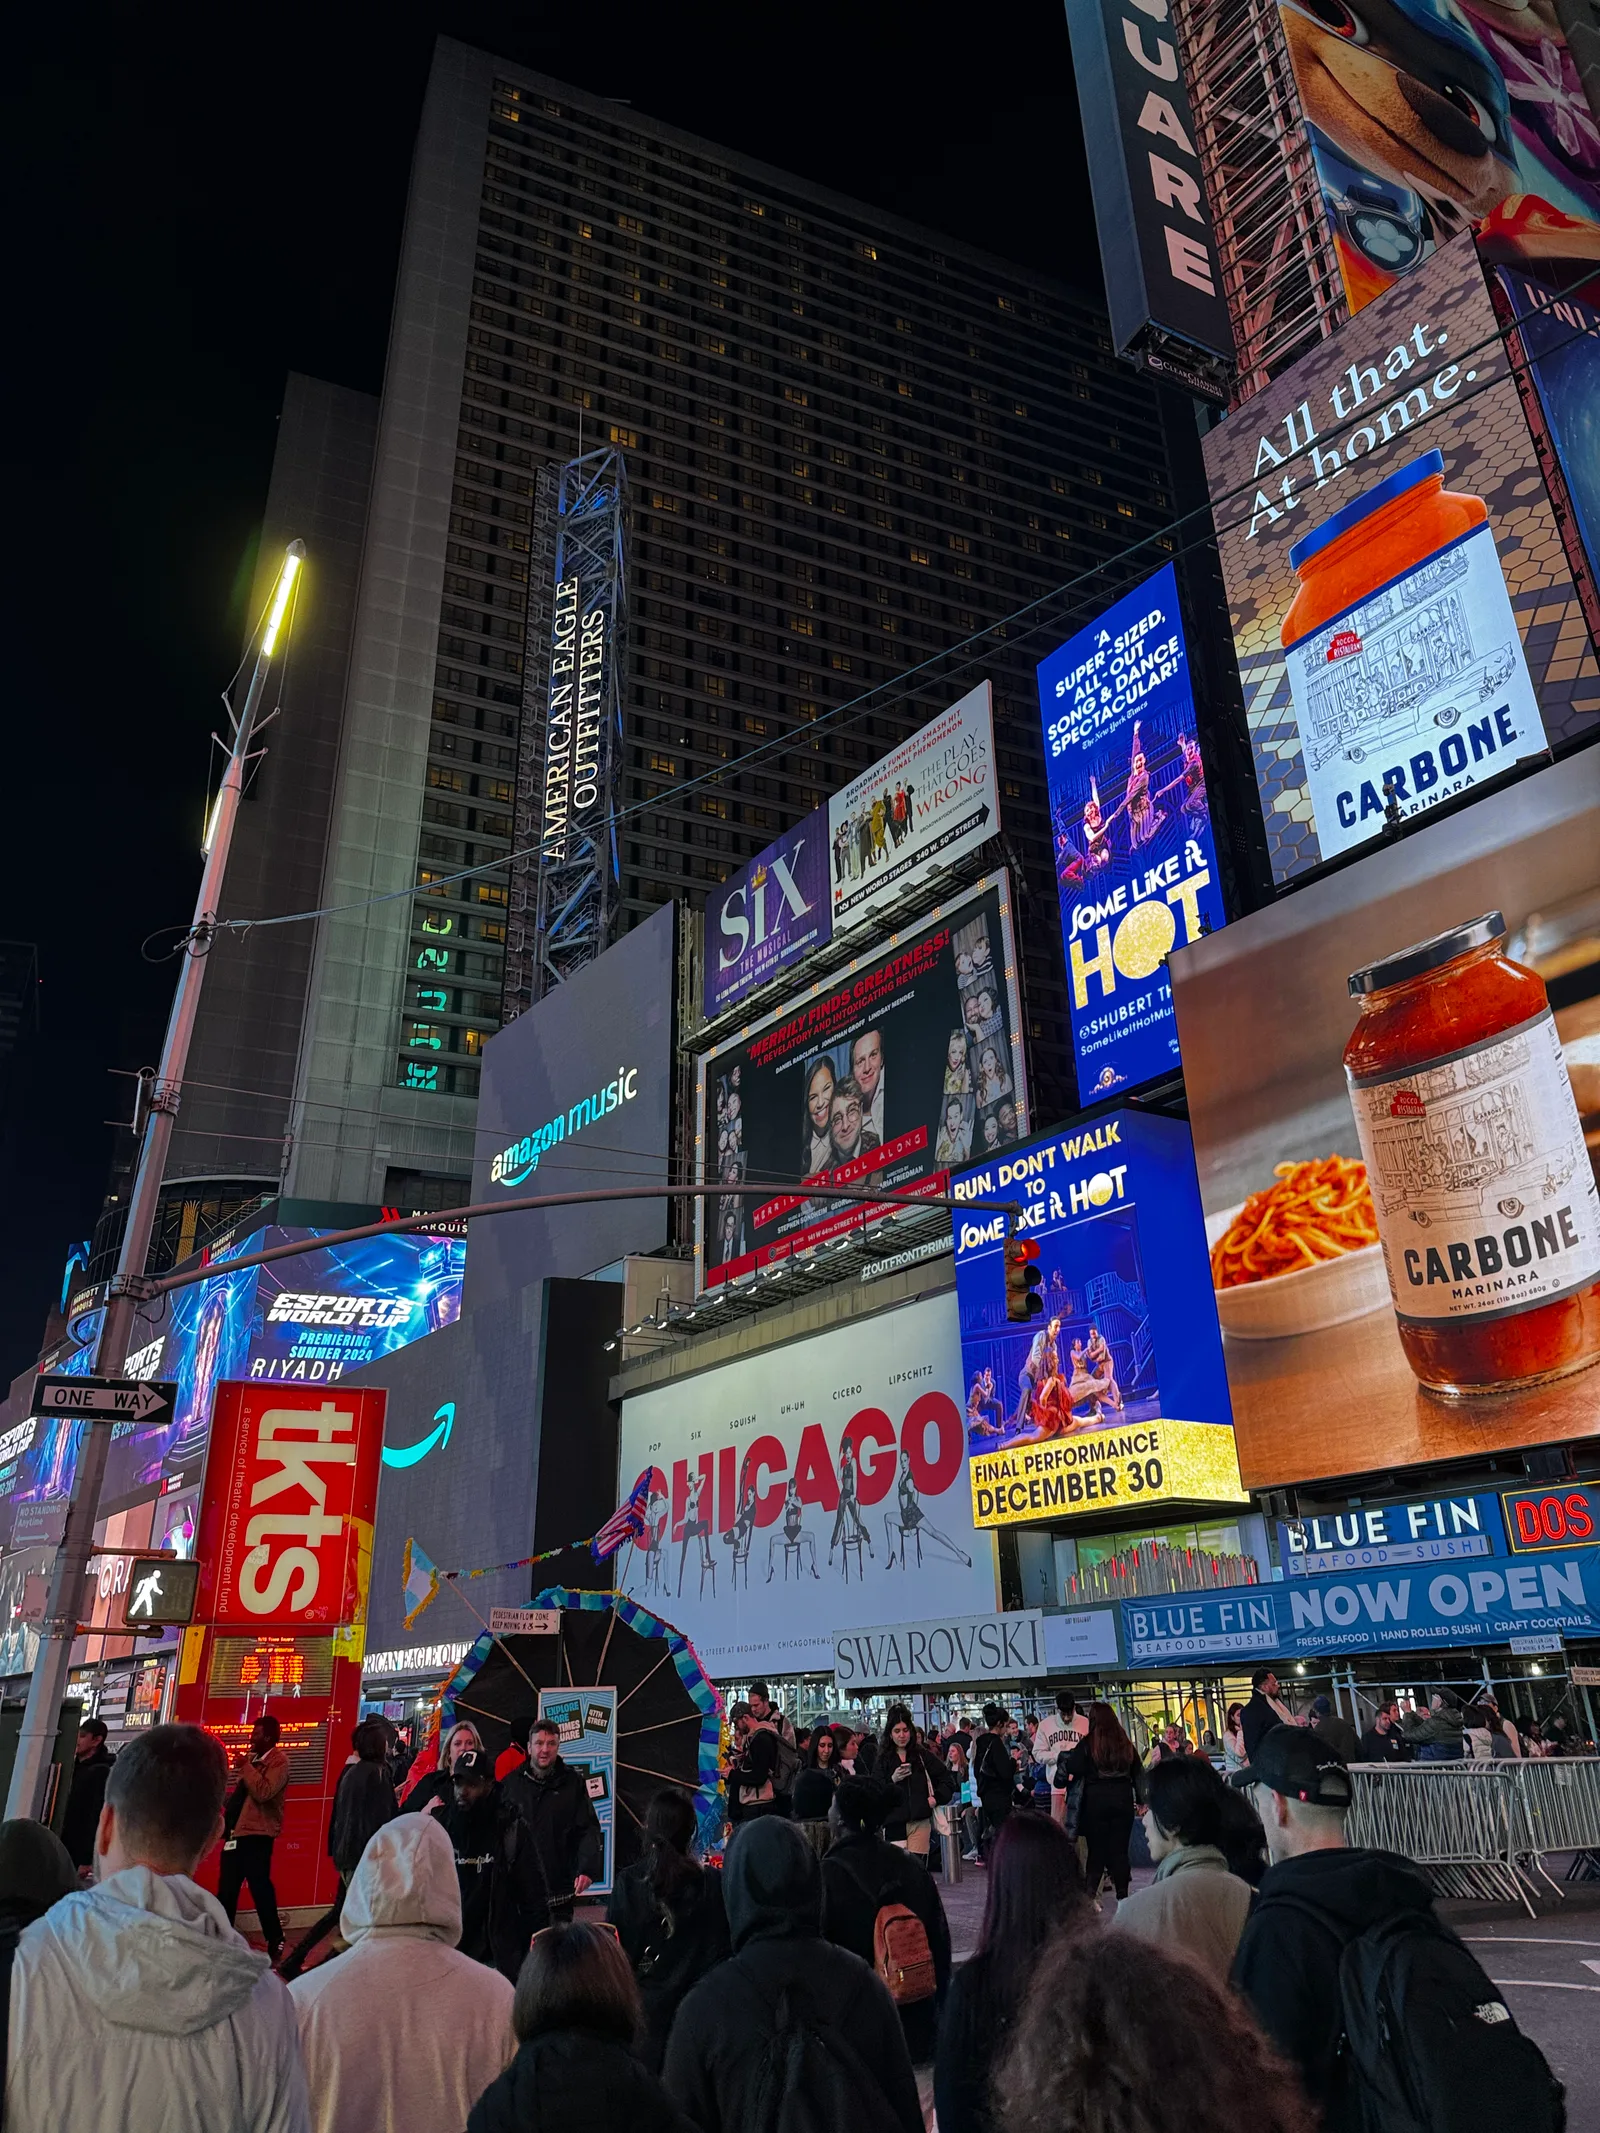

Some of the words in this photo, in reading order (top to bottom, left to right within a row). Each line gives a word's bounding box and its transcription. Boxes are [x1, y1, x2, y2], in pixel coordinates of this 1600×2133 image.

[1254, 401, 1319, 478] All
[1329, 323, 1448, 419] that.
[1246, 476, 1300, 540] At
[1308, 364, 1477, 491] home.
[553, 577, 578, 677] EAGLE
[573, 609, 604, 809] OUTFITTERS
[1048, 696, 1096, 741] SONG
[1100, 686, 1112, 703] &
[1116, 635, 1179, 693] DANCE
[1082, 738, 1095, 750] The
[1095, 727, 1109, 742] New
[1110, 716, 1126, 733] York
[1126, 701, 1148, 718] Times
[543, 682, 574, 860] AMERICAN
[845, 795, 859, 809] AND
[860, 757, 911, 797] INTERNATIONAL
[913, 718, 963, 760] PHENOMENON
[846, 764, 887, 798] BROADWAY'S
[888, 739, 920, 767] FUNNIEST
[922, 721, 947, 742] SMASH
[948, 709, 961, 725] HIT
[916, 771, 944, 799] THAT
[945, 740, 986, 780] GOES
[920, 759, 941, 780] THE
[944, 728, 978, 765] PLAY
[1336, 703, 1517, 828] CARBONE
[916, 764, 987, 817] WRONG
[1398, 774, 1476, 820] ARINARA
[850, 890, 865, 905] NEW
[865, 875, 888, 897] WORLD
[889, 859, 913, 880] STAGES
[916, 849, 930, 862] 340
[955, 815, 980, 836] STREET
[719, 839, 812, 972] SIX
[1069, 885, 1127, 941] SOME
[740, 956, 754, 974] THE
[757, 930, 791, 963] MUSICAL
[1069, 868, 1211, 1010] HOT
[809, 988, 850, 1025] FINDS
[853, 928, 950, 998] GREATNESS!
[756, 1058, 763, 1068] A
[763, 1028, 814, 1065] REVELATORY
[814, 1019, 831, 1035] AND
[833, 981, 894, 1024] INTOXICATING
[776, 1061, 792, 1074] DANIEL
[793, 1045, 819, 1062] RADCLIFFE
[822, 1030, 847, 1048] JONATHAN
[848, 1018, 865, 1033] GROFF
[868, 1003, 891, 1021] LINDSAY
[892, 990, 915, 1008] MENDEZ
[1091, 993, 1152, 1036] SHUBERT
[490, 1114, 565, 1184] amazon
[568, 1066, 638, 1136] music
[837, 1162, 868, 1182] ROLL
[879, 1134, 921, 1161] ALONG
[893, 1165, 924, 1184] FRIEDMAN
[954, 1172, 996, 1200] RUN,
[1061, 1120, 1122, 1161] WALK
[958, 1216, 1004, 1254] SOME
[1069, 1165, 1128, 1215] HOT
[1025, 1178, 1046, 1198] TO
[777, 1220, 800, 1234] STEPHEN
[800, 1207, 828, 1224] SONDHEIM
[833, 1217, 853, 1230] STREET
[1404, 1206, 1579, 1286] CARBONE
[1452, 1270, 1539, 1299] MARINARA
[267, 1308, 355, 1326] WORLD
[359, 1312, 410, 1328] CUP
[298, 1332, 371, 1347] PREMIERING
[250, 1357, 344, 1381] RIYADH
[289, 1346, 342, 1360] SUMMER
[344, 1348, 373, 1361] 2024
[888, 1365, 933, 1385] LIPSCHITZ
[54, 1389, 95, 1406] ONE
[114, 1392, 156, 1410] WAY
[780, 1401, 805, 1415] UH-UH
[832, 1384, 862, 1401] CICERO
[239, 1416, 251, 1455] service
[690, 1430, 702, 1441] SIX
[729, 1414, 757, 1430] SQUISH
[236, 1457, 246, 1469] of
[648, 1442, 661, 1453] POP
[975, 1460, 1020, 1484] FINAL
[1024, 1431, 1160, 1474] PERFORMANCE
[232, 1471, 245, 1509] theatre
[632, 1391, 964, 1551] CHICAGO
[978, 1466, 1117, 1517] DECEMBER
[1128, 1458, 1164, 1492] 30
[17, 1517, 43, 1529] Anytime
[20, 1507, 29, 1517] NO
[29, 1504, 61, 1516] STANDING
[238, 1401, 356, 1615] tkts
[1287, 1510, 1388, 1553] BLUE
[1407, 1498, 1480, 1539] FIN
[1514, 1494, 1593, 1544] DOS
[223, 1512, 240, 1585] development
[1292, 1550, 1388, 1571] SEAFOOD
[1417, 1540, 1485, 1559] SUSHI
[218, 1586, 232, 1613] fund
[535, 1612, 549, 1621] ZONE
[1291, 1579, 1411, 1629] NOW
[1428, 1561, 1586, 1617] OPEN
[1133, 1607, 1206, 1639] BLUE
[1219, 1600, 1270, 1631] FIN
[1296, 1636, 1323, 1648] FRESH
[1325, 1632, 1369, 1645] SEAFOOD
[1380, 1629, 1409, 1640] HAND
[1411, 1625, 1449, 1638] ROLLED
[1451, 1623, 1481, 1636] SUSHI
[1494, 1619, 1527, 1632] CRAFT
[1530, 1614, 1591, 1630] COCKTAILS
[737, 1643, 770, 1653] BROADWAY
[837, 1620, 1043, 1680] SWAROVSKI
[1137, 1639, 1206, 1654] SEAFOOD
[1225, 1634, 1274, 1647] SUSHI
[546, 1701, 579, 1717] EXPLORE
[558, 1719, 580, 1732] TIMES
[586, 1716, 608, 1727] STREET
[1049, 1730, 1084, 1748] BROOKLY
